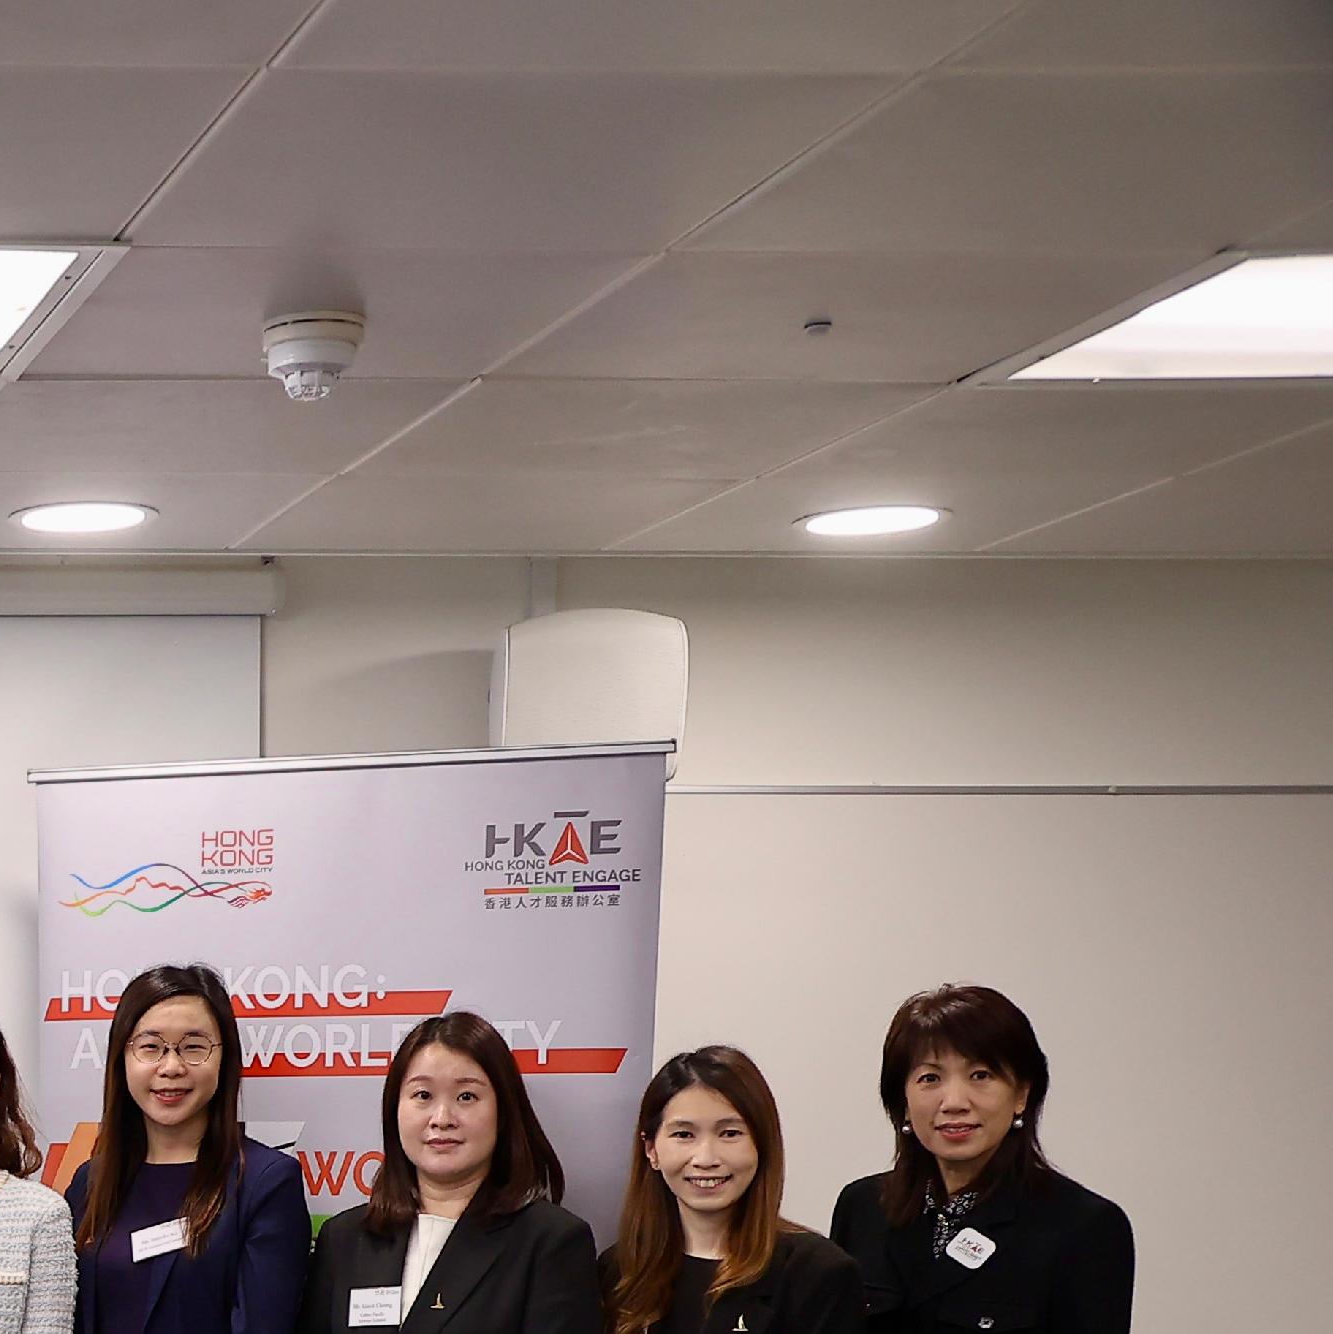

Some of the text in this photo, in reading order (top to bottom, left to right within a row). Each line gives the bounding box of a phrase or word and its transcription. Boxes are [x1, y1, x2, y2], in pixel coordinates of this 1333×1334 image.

[201, 828, 274, 848] HONG
[201, 848, 274, 867] KONG
[464, 859, 545, 872] HONG KONG
[505, 869, 641, 886] TALENT ENGAGE
[60, 963, 386, 1013] HO KONG:
[493, 1020, 562, 1065] TY
